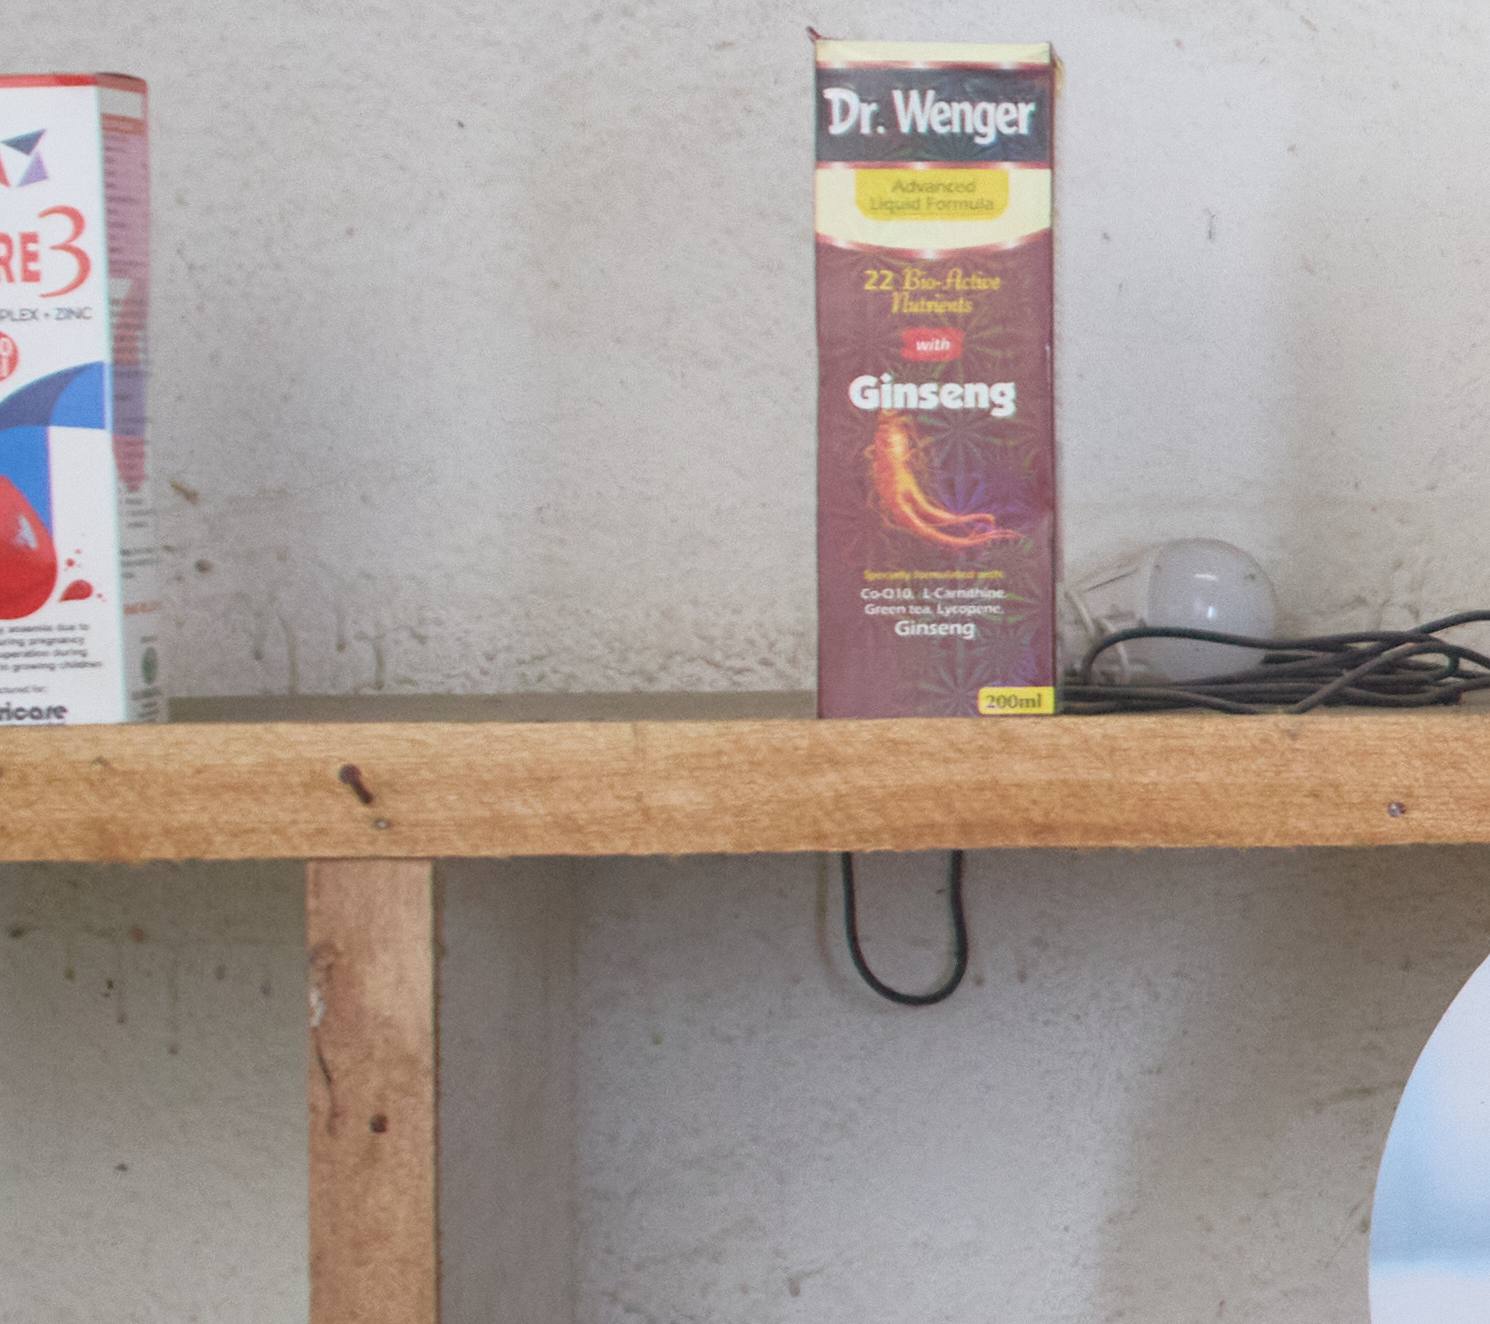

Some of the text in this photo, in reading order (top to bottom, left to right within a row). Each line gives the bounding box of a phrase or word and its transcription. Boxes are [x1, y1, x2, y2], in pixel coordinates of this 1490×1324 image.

[822, 87, 1036, 146] Dr. Wenger
[864, 268, 1001, 291] 22 Bio-Active
[916, 338, 951, 351] with
[848, 372, 1016, 418] Ginseng
[895, 620, 975, 640] Ginseng
